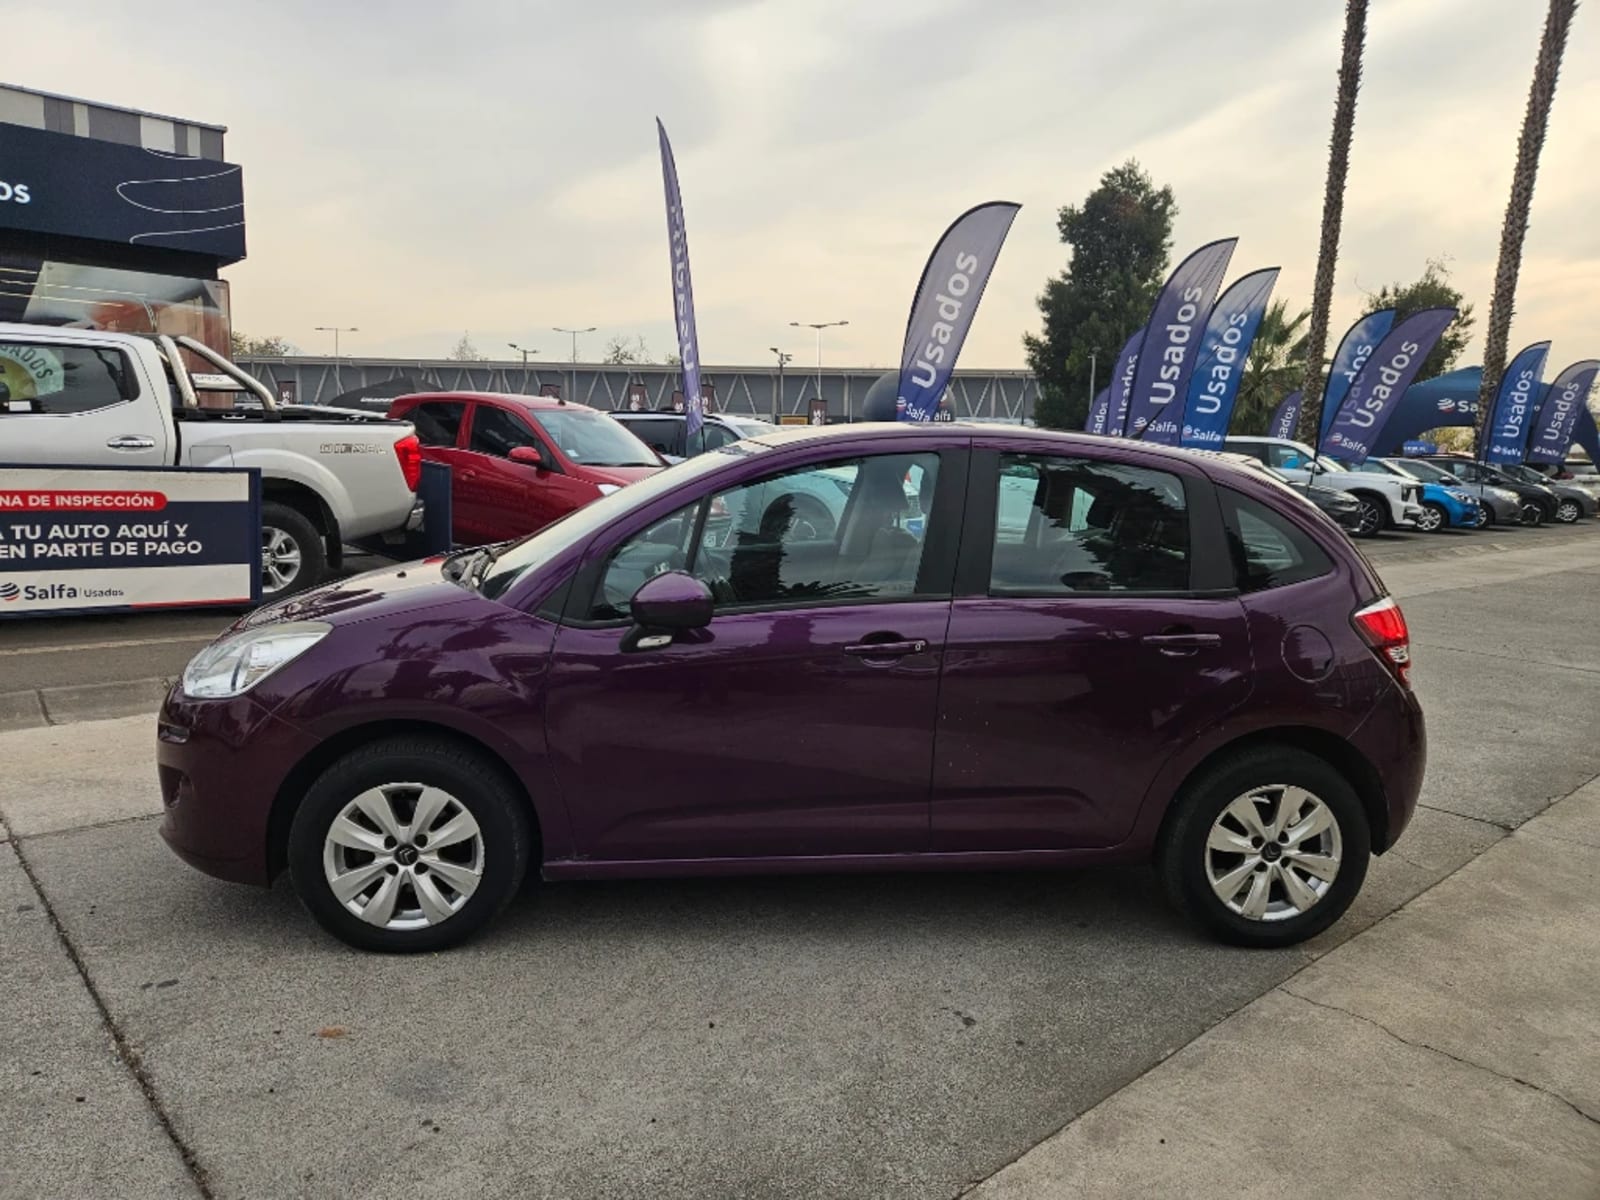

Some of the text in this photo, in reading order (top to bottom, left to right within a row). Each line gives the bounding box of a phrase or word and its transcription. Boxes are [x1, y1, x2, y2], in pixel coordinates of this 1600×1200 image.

[912, 251, 978, 389] Usados
[1149, 286, 1202, 404] Usados
[1196, 312, 1248, 414] Usados
[1350, 340, 1419, 428] Usados
[1502, 370, 1534, 438] Usados
[1543, 382, 1580, 440] Usados
[1148, 420, 1178, 434] Salfa
[1192, 428, 1222, 442] Salfa
[1341, 436, 1368, 454] Salfa
[28, 495, 51, 507] DE
[55, 493, 155, 507] INSPECCIÓN
[10, 525, 42, 540] TU
[48, 524, 110, 540] AUTO
[116, 521, 169, 539] AQUÍ
[174, 523, 189, 538] Y
[0, 540, 202, 559] EN PARTE DE PAGO
[24, 584, 125, 601] Salfa Usados
